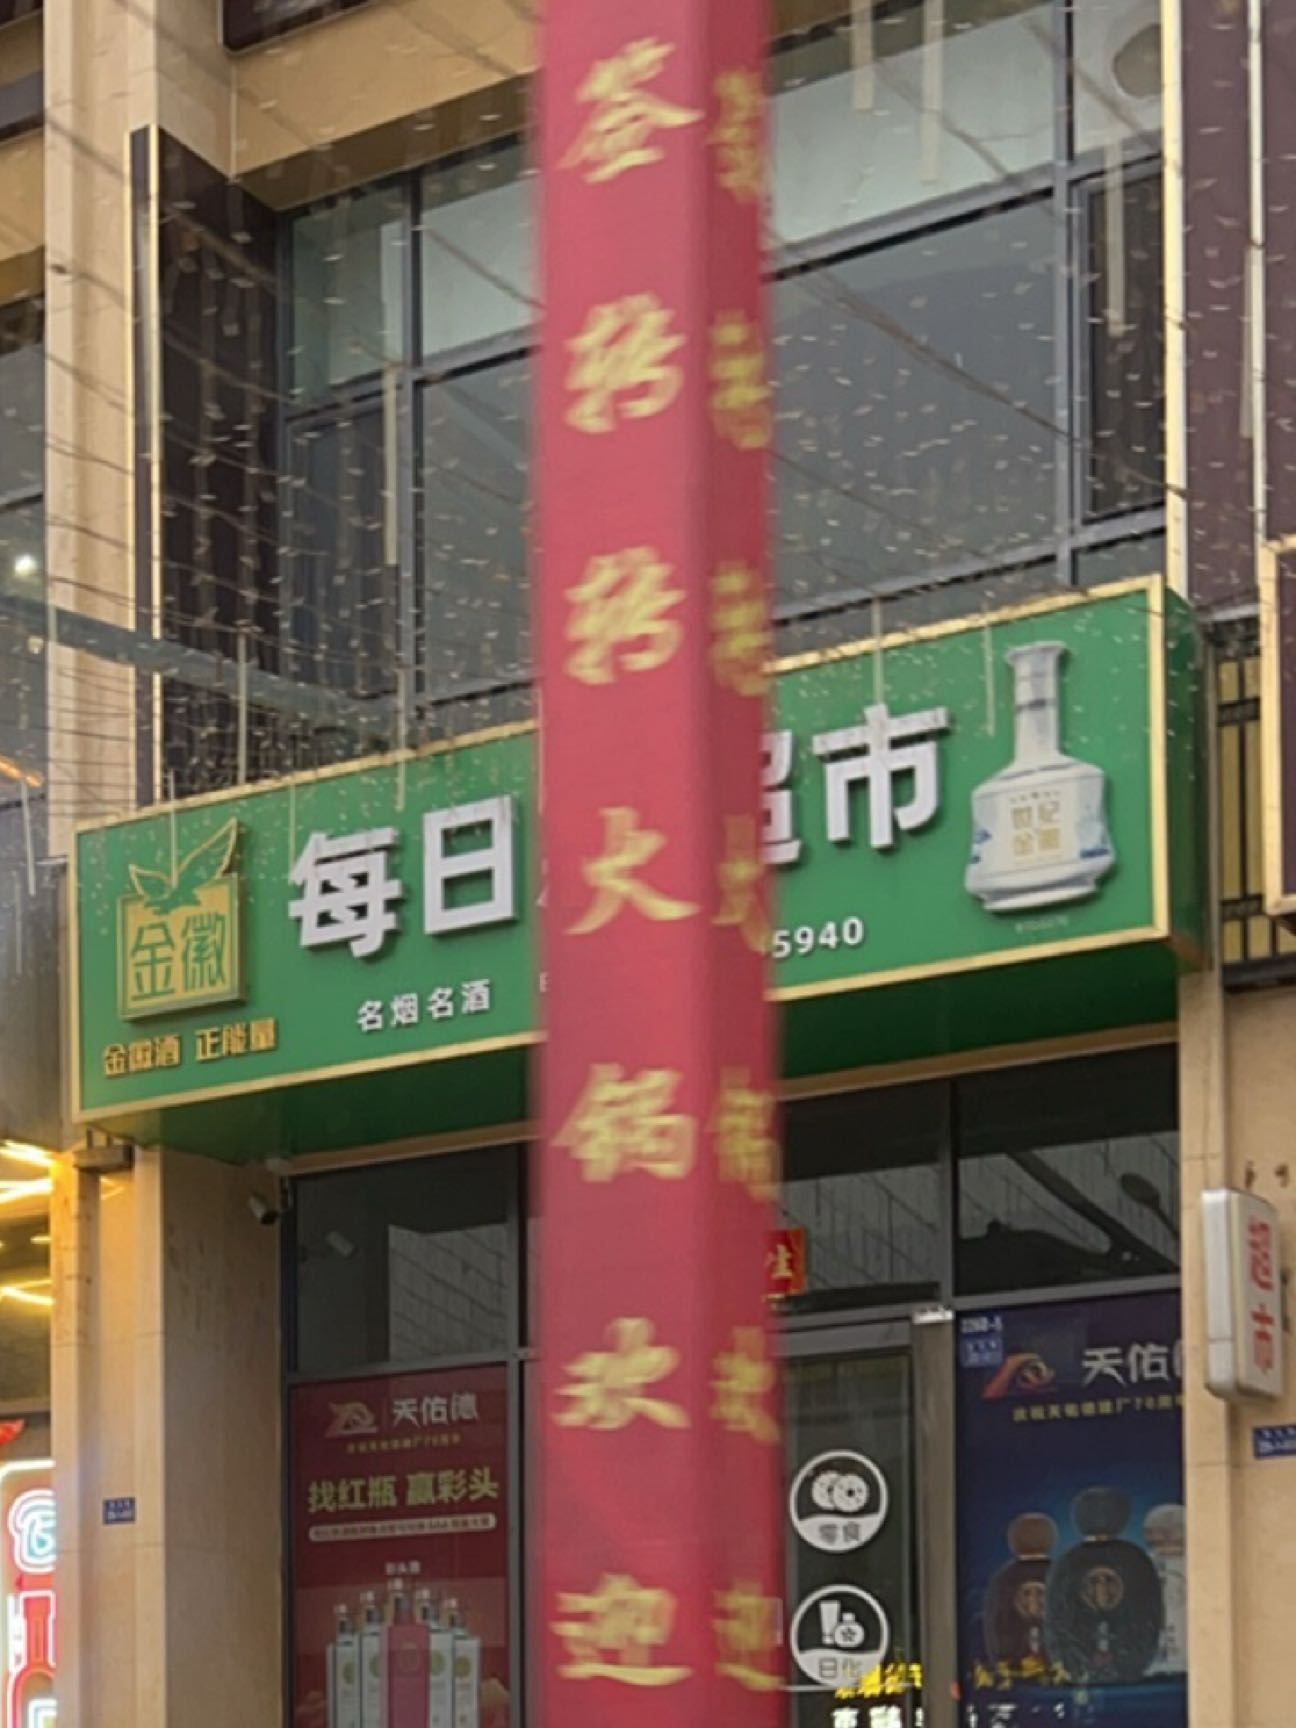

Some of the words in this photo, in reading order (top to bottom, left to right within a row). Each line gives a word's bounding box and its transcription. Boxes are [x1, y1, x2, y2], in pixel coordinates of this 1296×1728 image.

[131, 913, 226, 1001] 金徽
[772, 916, 864, 958] 5940
[357, 979, 490, 1032] 名烟名酒
